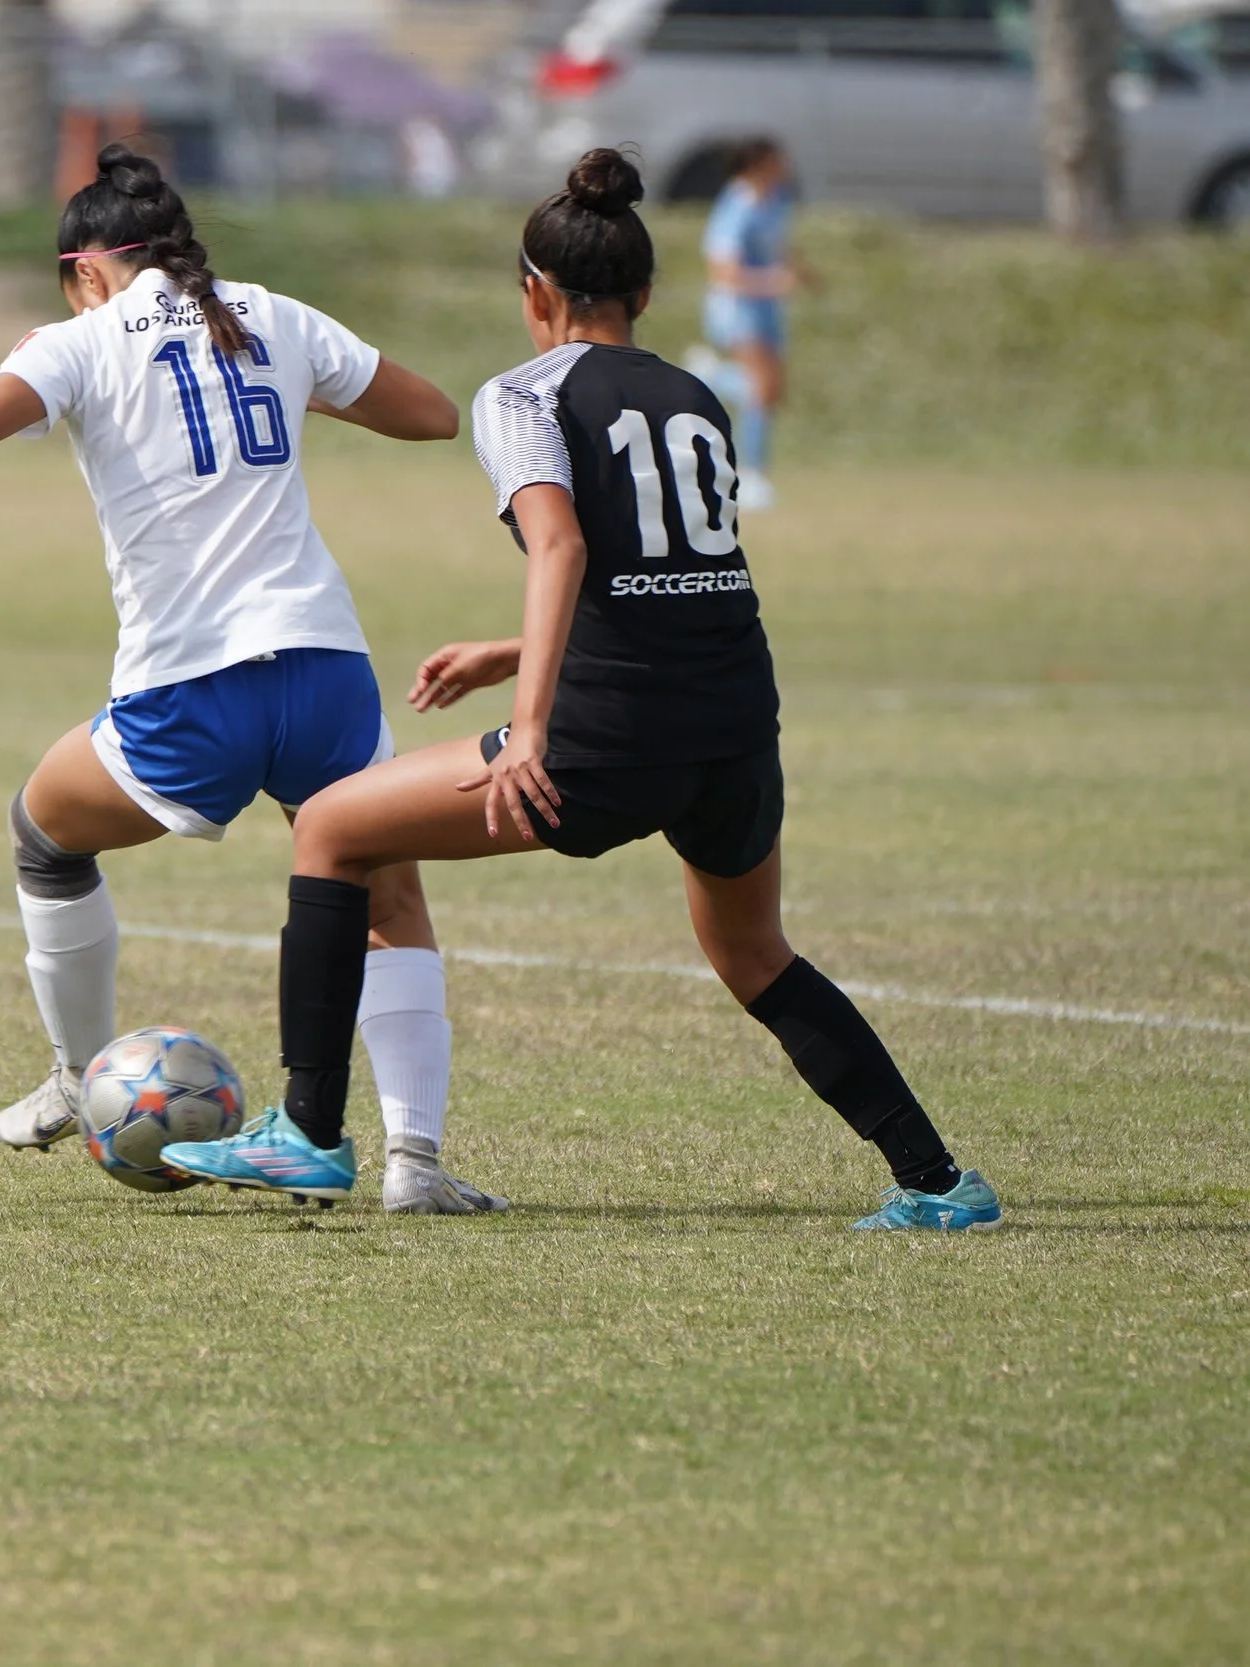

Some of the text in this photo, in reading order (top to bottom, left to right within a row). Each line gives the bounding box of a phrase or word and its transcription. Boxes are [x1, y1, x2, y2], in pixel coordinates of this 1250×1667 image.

[125, 302, 248, 332] LOS ANGS
[152, 332, 291, 476] 16
[608, 409, 737, 557] 10
[610, 569, 751, 595] SOCCER.COM
